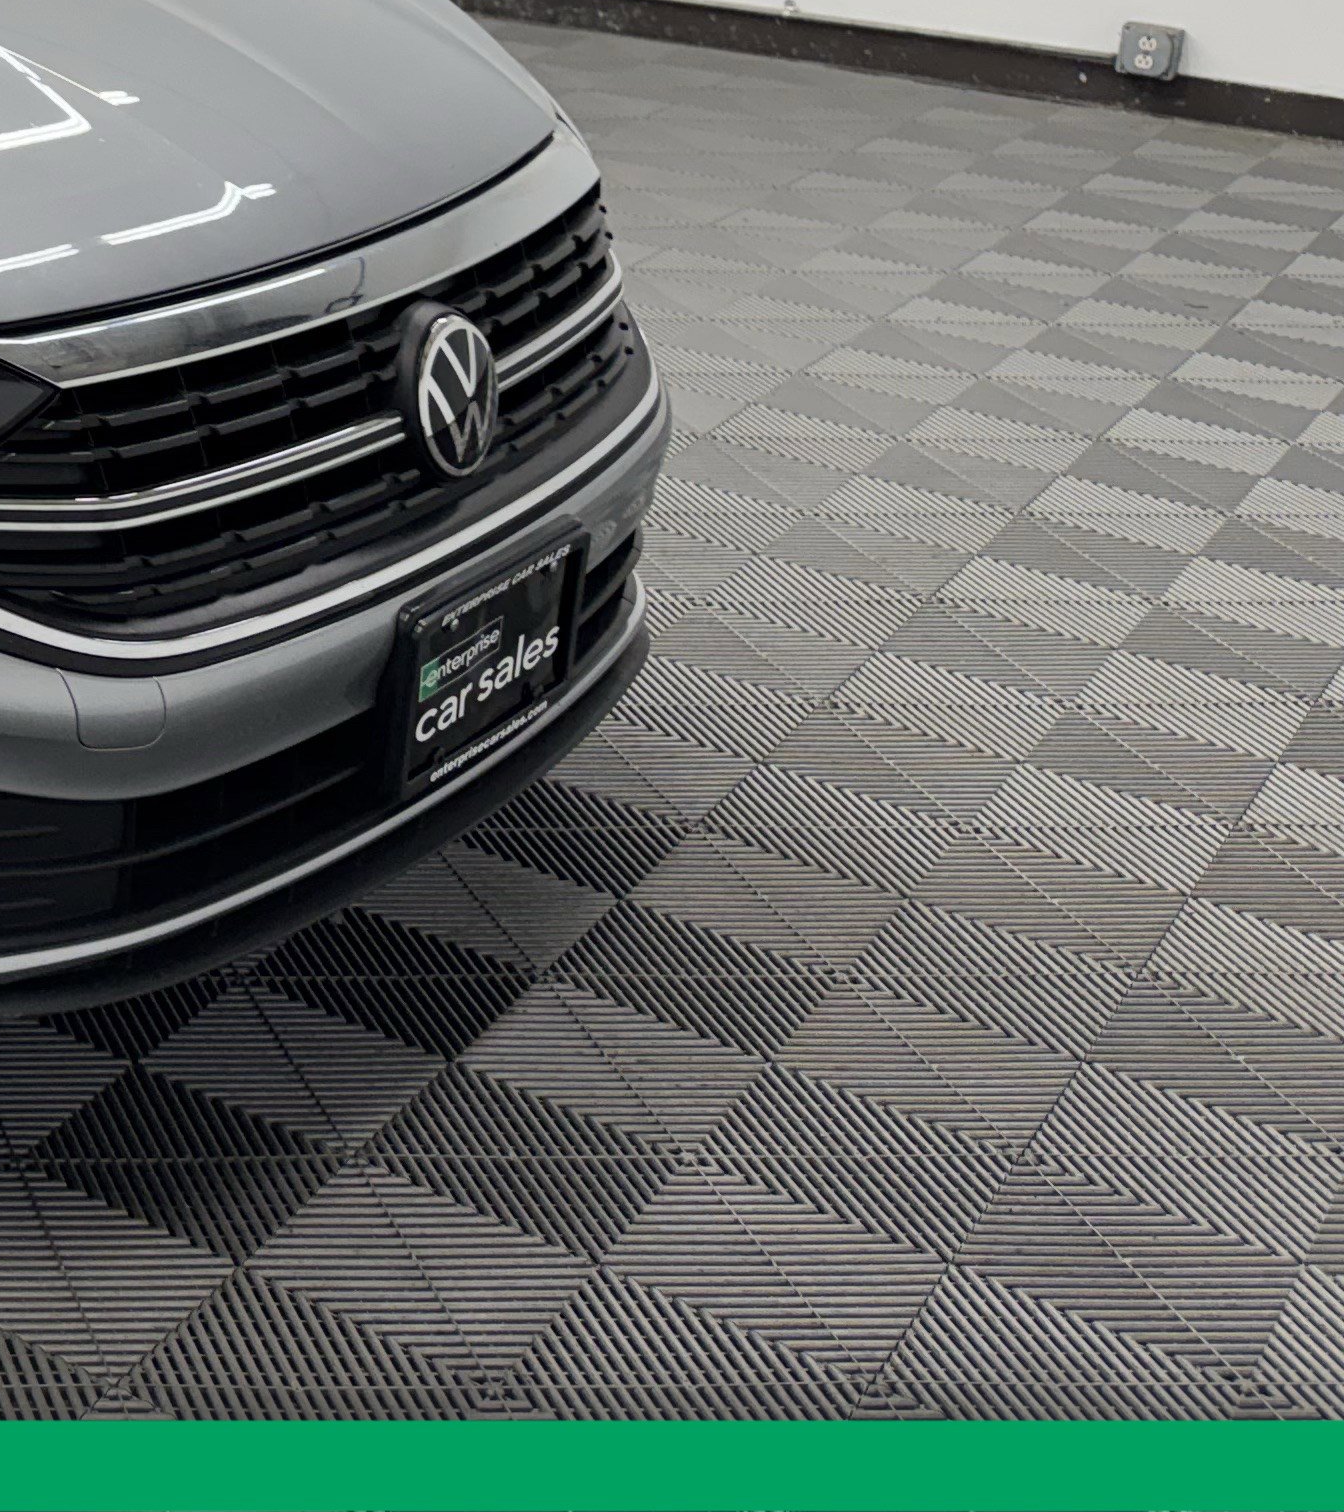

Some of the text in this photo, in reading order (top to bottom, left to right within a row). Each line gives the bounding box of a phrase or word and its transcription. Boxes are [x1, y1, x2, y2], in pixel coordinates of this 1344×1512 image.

[415, 626, 560, 742] car sales
[423, 629, 501, 687] enterprise
